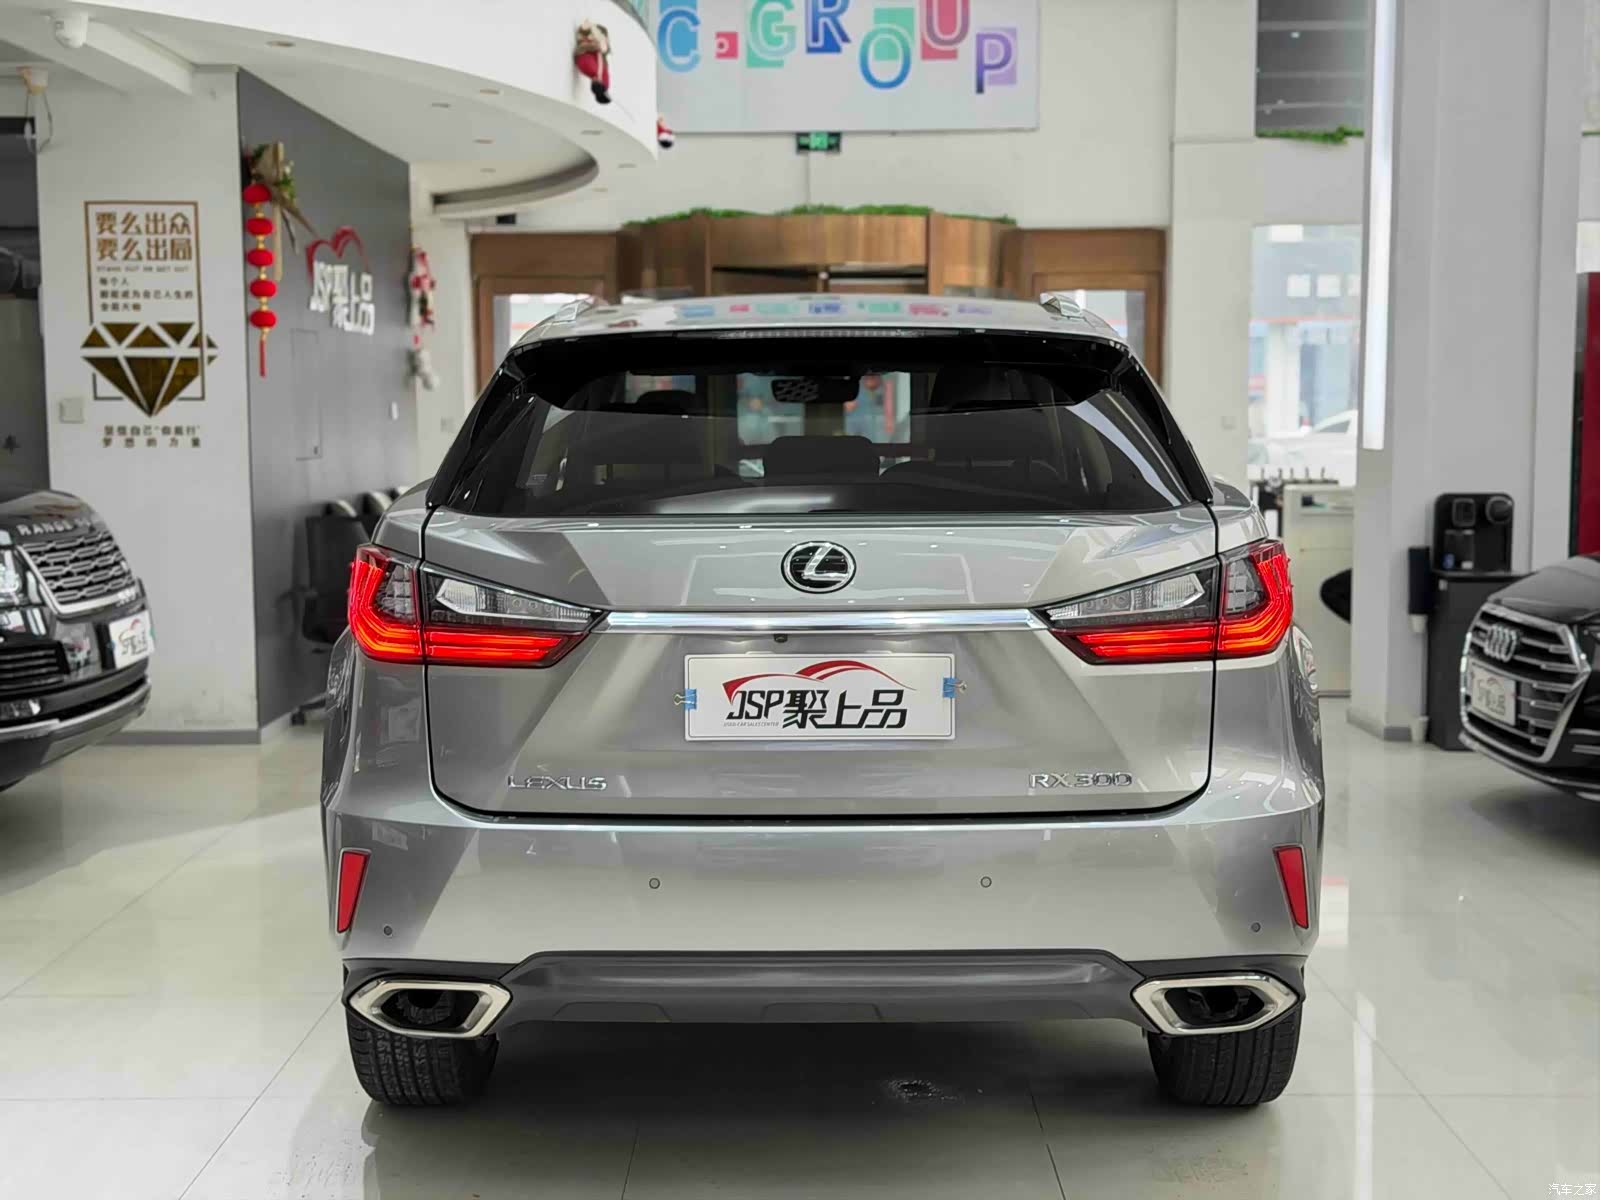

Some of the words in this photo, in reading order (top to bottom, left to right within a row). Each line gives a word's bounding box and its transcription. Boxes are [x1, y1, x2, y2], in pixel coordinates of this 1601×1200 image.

[95, 211, 191, 235] 要么出众
[96, 238, 192, 261] 要么出局
[507, 775, 607, 791] LEXUS
